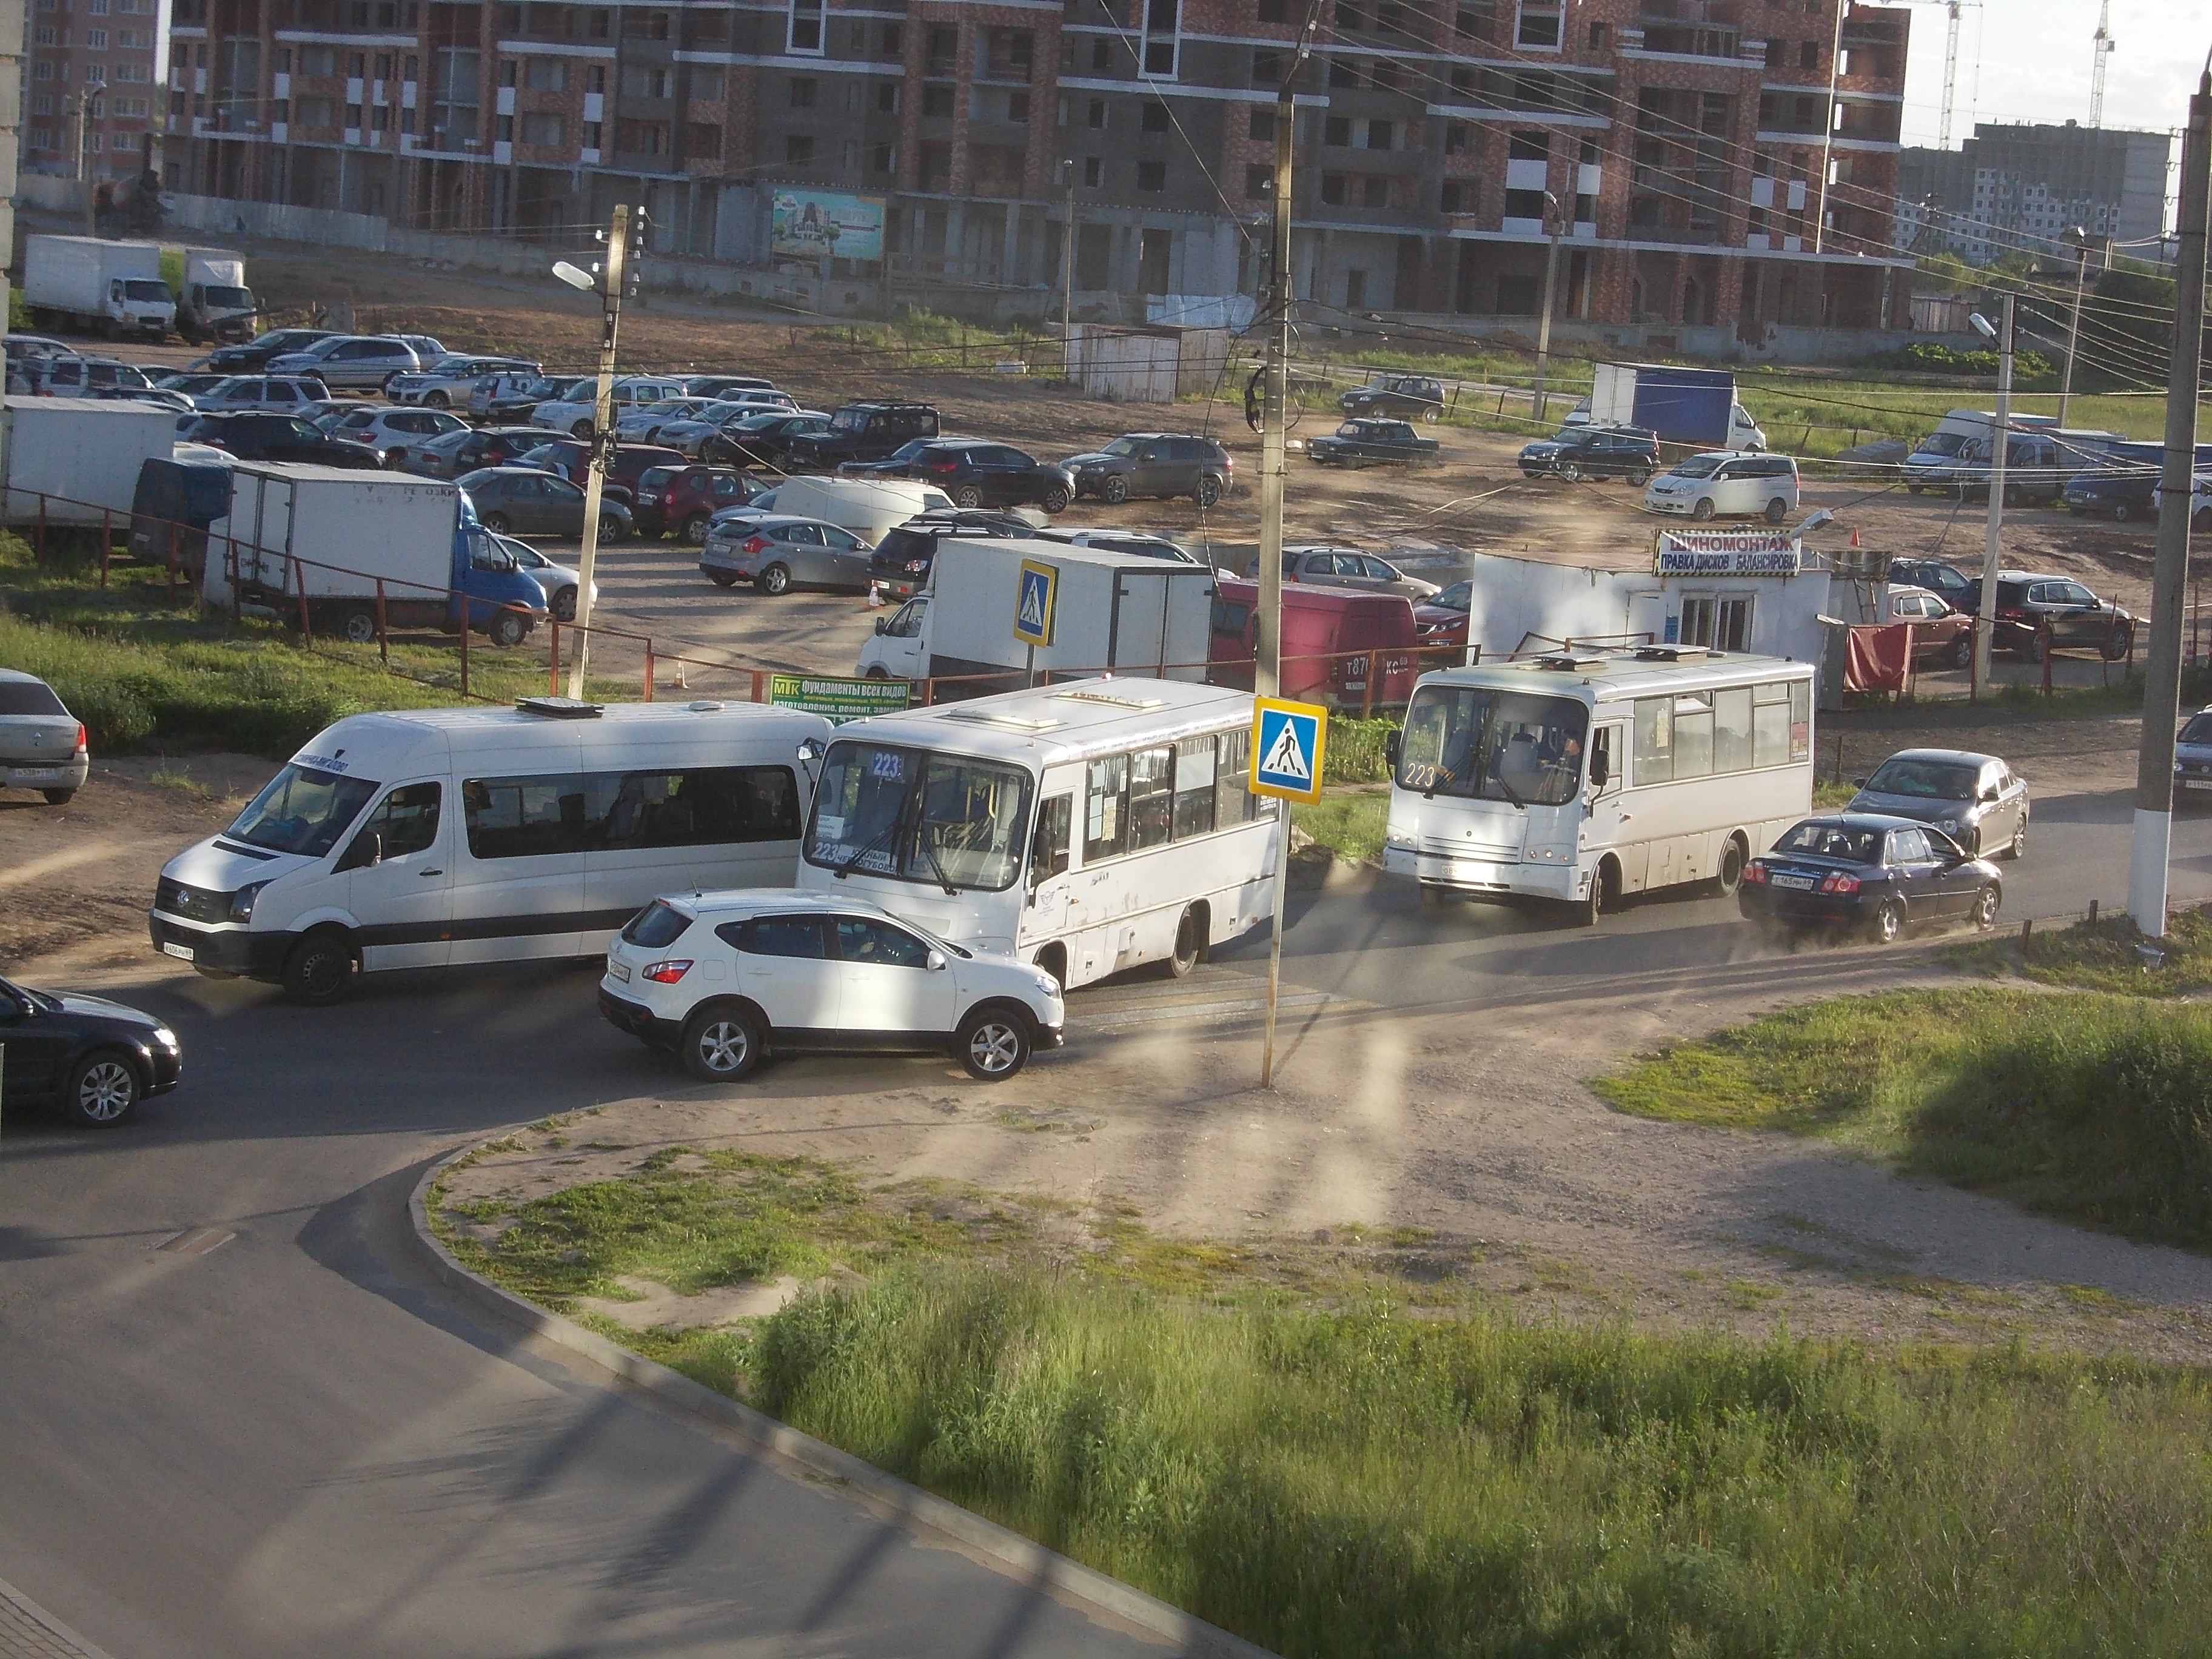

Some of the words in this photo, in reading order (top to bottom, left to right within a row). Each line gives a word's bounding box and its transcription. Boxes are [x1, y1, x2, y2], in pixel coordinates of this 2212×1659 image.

[1670, 537, 1794, 551] ШИНОМОНТАЖ
[1660, 554, 1694, 569] ПРАВКА
[1695, 555, 1729, 571] ДИСКОВ
[1736, 554, 1798, 570] БАЛАНСИРОВКА
[774, 679, 800, 695] МТК
[862, 685, 881, 697] всех
[882, 686, 907, 699] видов
[874, 752, 899, 777] 223
[1405, 763, 1435, 786] 223
[813, 842, 839, 861] 223
